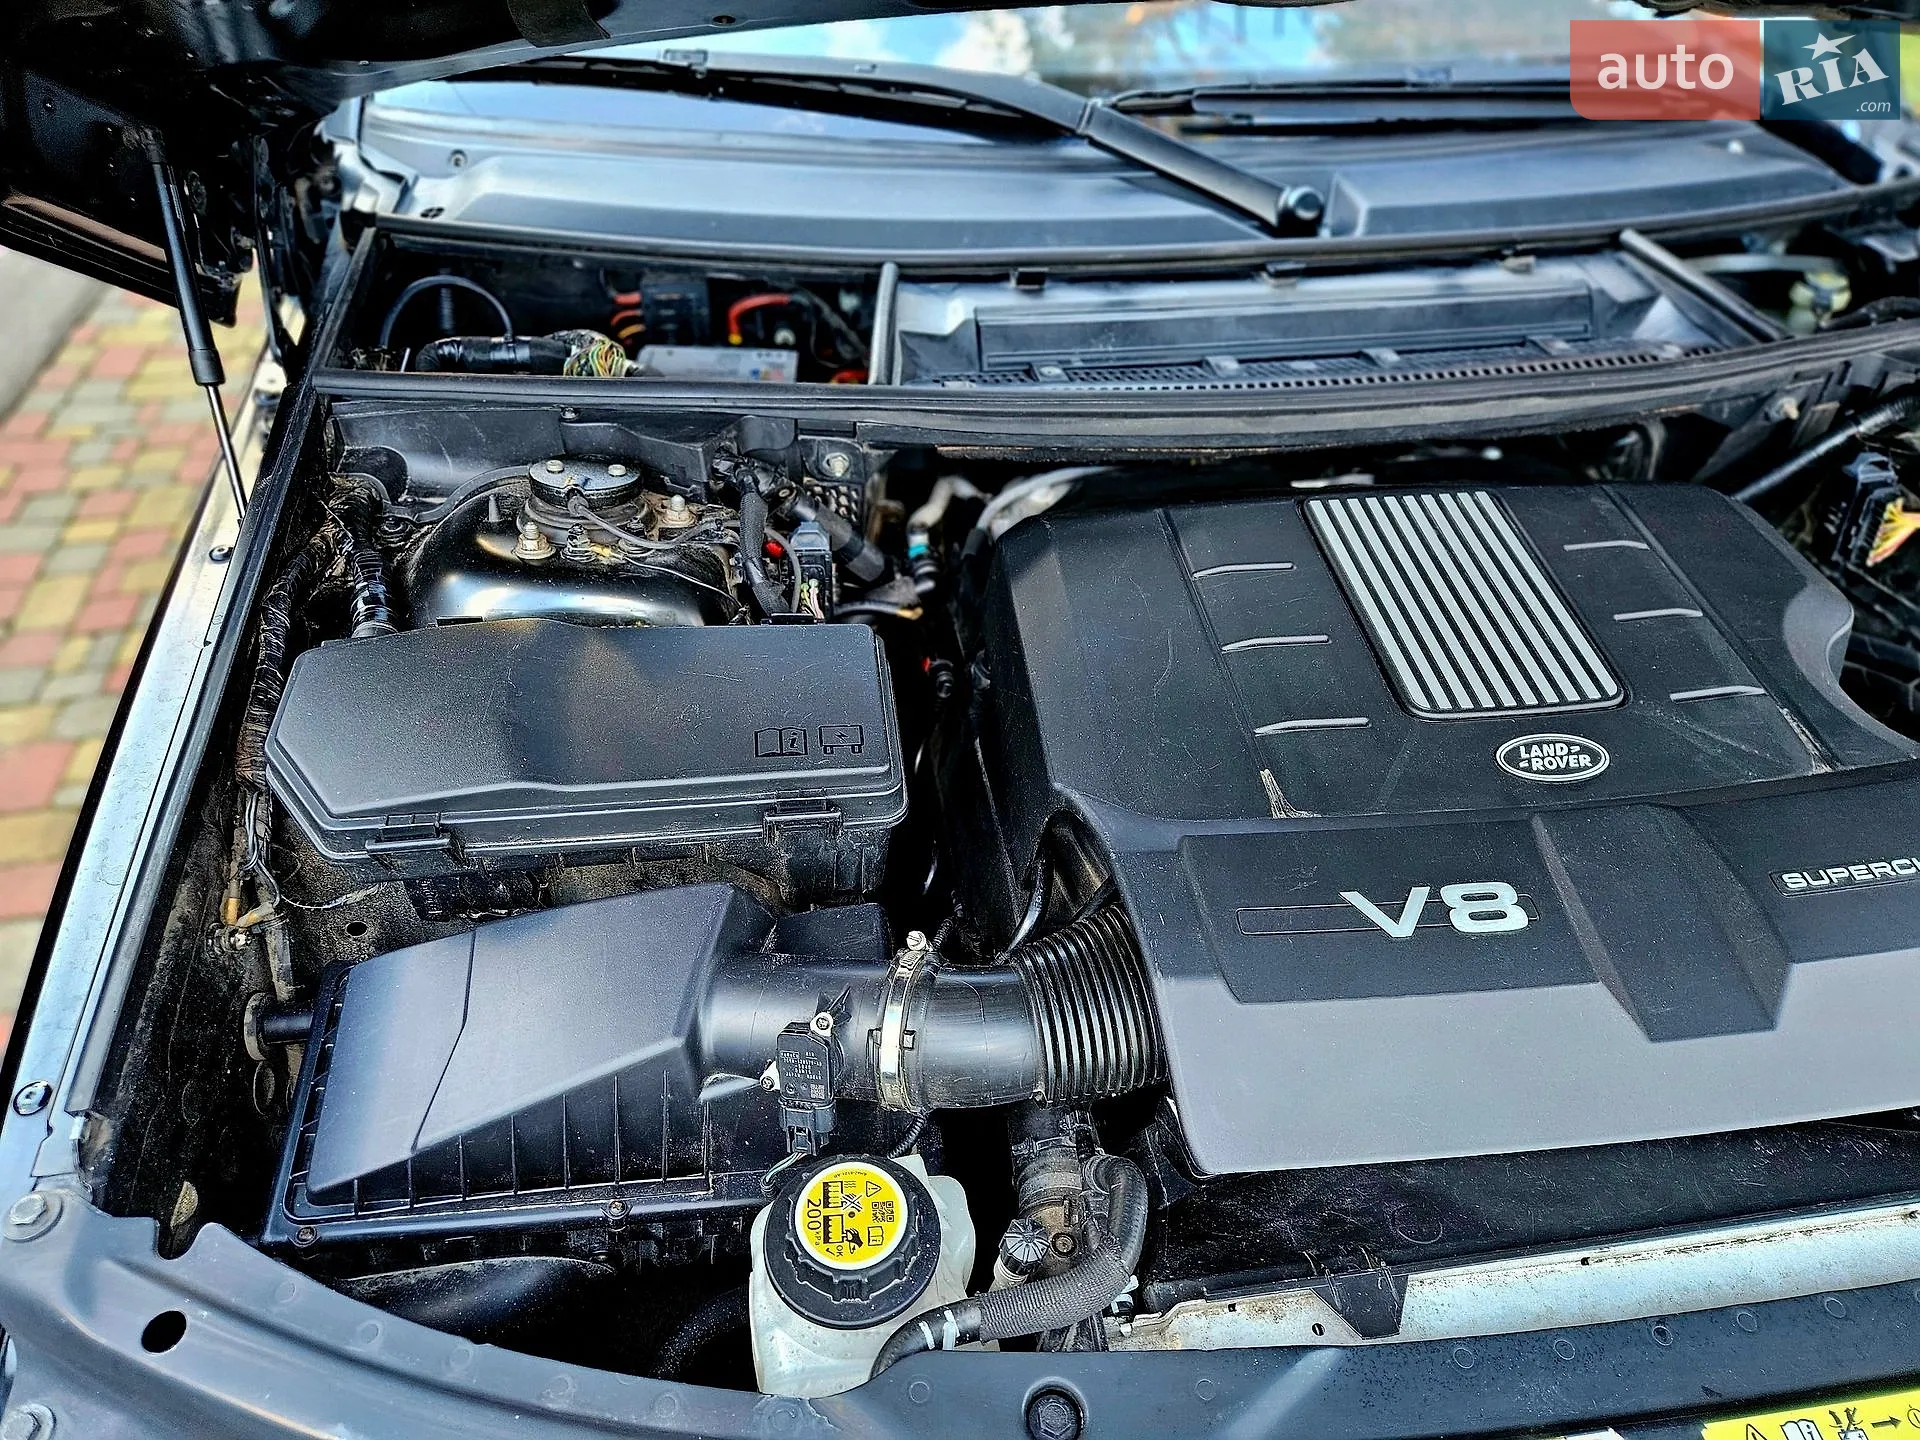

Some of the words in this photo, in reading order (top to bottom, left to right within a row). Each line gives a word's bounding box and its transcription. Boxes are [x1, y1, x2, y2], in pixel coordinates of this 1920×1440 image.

[1519, 742, 1569, 759] LAND
[1531, 754, 1593, 771] ROVER
[1338, 881, 1529, 938] V8
[806, 1198, 822, 1231] 200
[836, 1245, 844, 1257] OK
